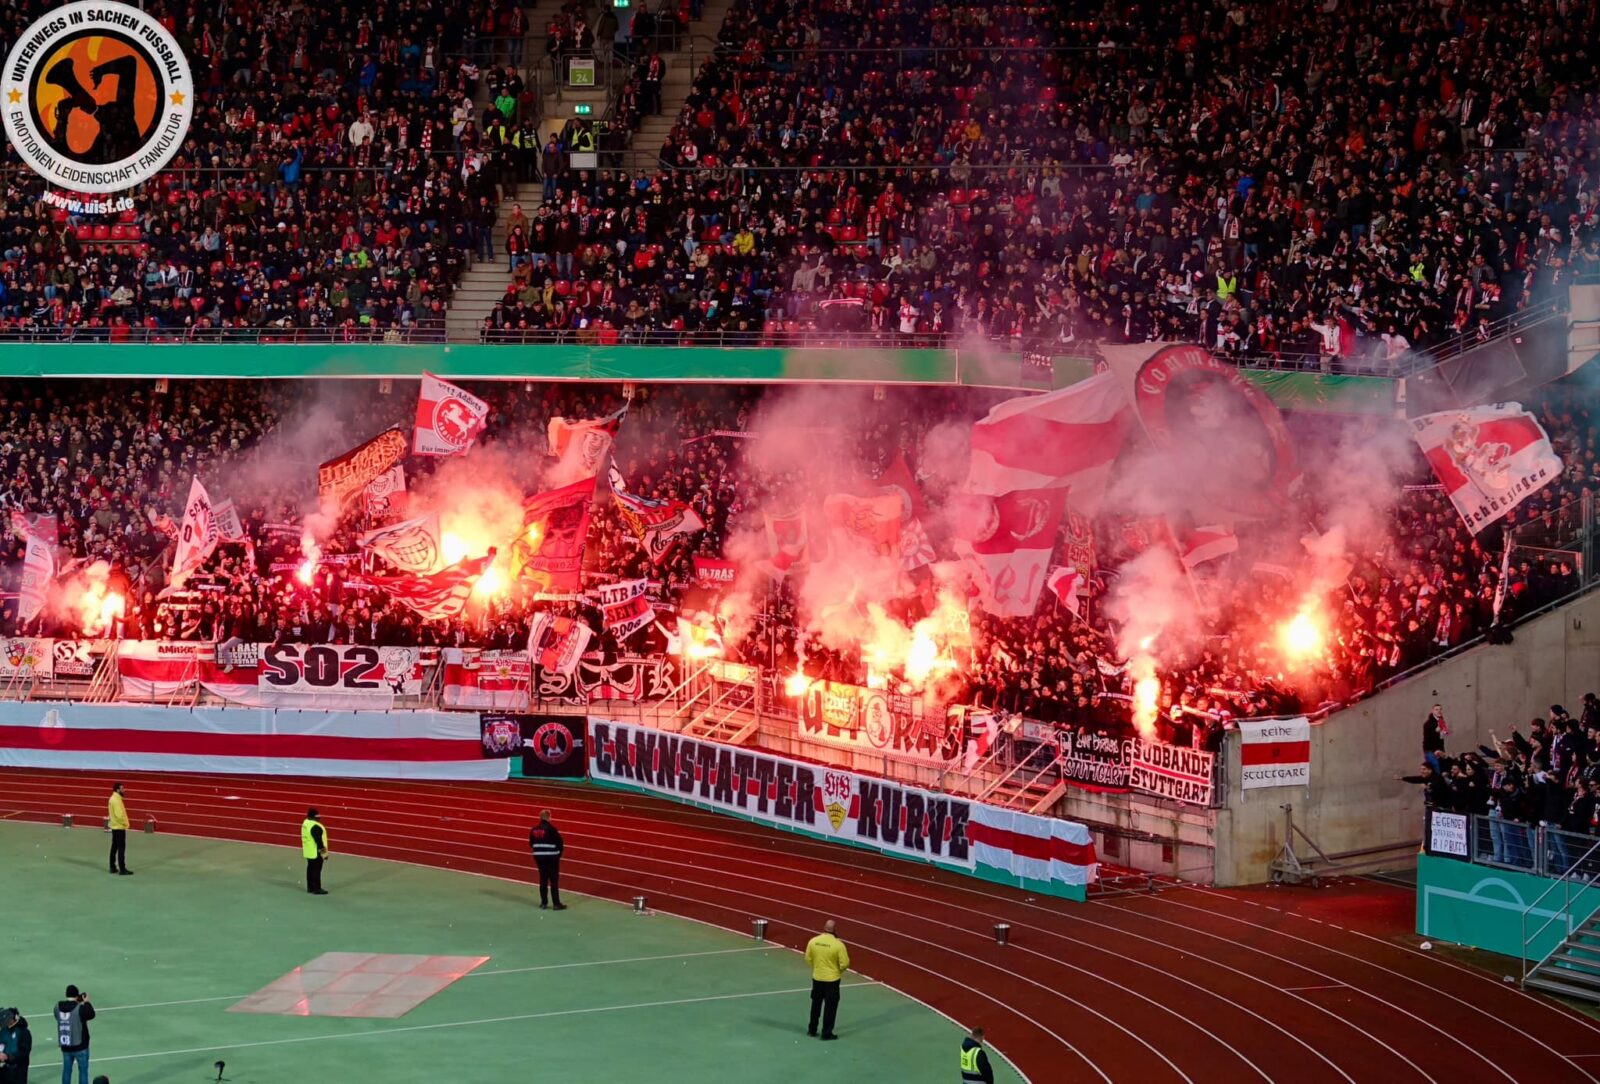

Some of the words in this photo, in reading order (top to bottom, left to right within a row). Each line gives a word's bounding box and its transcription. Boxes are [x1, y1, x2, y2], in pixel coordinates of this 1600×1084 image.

[699, 567, 735, 581] ULTRAS
[606, 603, 637, 622] SEIT
[1064, 759, 1126, 786] STUTTGART
[1131, 768, 1210, 803] STUTTGART
[594, 724, 816, 826] CANNSTATTER
[857, 780, 971, 862] KURVE
